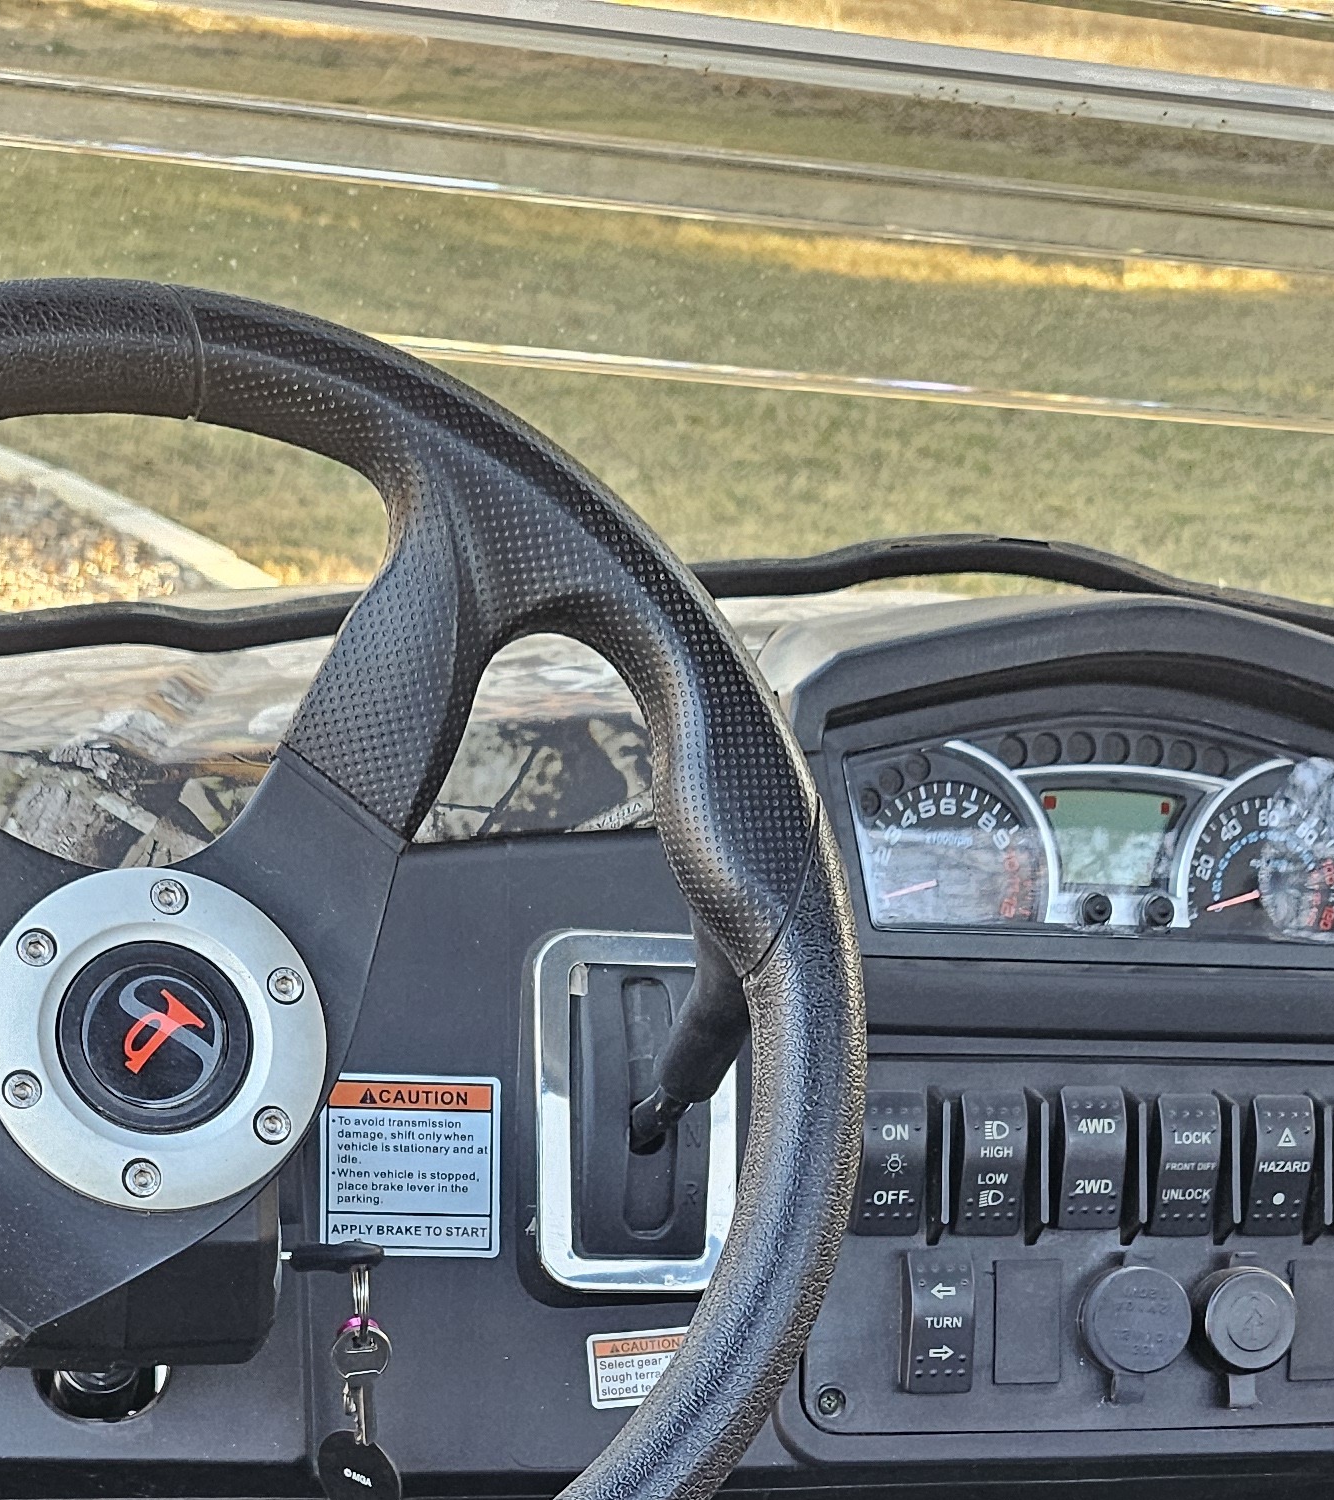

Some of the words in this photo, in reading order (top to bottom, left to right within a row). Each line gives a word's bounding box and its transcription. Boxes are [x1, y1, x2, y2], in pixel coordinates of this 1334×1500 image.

[918, 799, 936, 818] 5
[940, 798, 956, 815] 6
[961, 801, 979, 818] 7
[901, 808, 917, 828] 4
[978, 811, 997, 832] 8
[1258, 809, 1280, 826] 60
[1221, 818, 1242, 841] 40
[1296, 822, 1318, 846] 80
[993, 829, 1010, 850] 9
[1196, 854, 1215, 881] 20
[379, 1090, 468, 1105] CAUTION
[338, 1117, 351, 1127] To
[354, 1117, 385, 1127] avoid
[389, 1118, 462, 1129] transmission
[1078, 1119, 1115, 1135] 4WD
[337, 1130, 387, 1142] damage,
[391, 1131, 415, 1140] shift
[418, 1131, 442, 1144] only
[444, 1132, 474, 1142] when
[882, 1125, 909, 1141] ON
[1174, 1132, 1211, 1145] LOCK
[337, 1142, 378, 1152] vehicle
[381, 1144, 390, 1152] is
[393, 1144, 449, 1156] stationary
[453, 1145, 474, 1154] and
[477, 1145, 488, 1155] at
[980, 1146, 1013, 1158] HIGH
[337, 1154, 362, 1164] idle.
[1165, 1162, 1194, 1171] FRONT
[1197, 1162, 1217, 1171] DIFF
[1258, 1161, 1310, 1173] HAZARD
[337, 1168, 370, 1179] When
[374, 1169, 414, 1180] vehicle
[418, 1170, 427, 1180] is
[430, 1172, 479, 1184] stopped,
[978, 1173, 1008, 1186] LOW
[337, 1182, 368, 1193] place
[371, 1182, 404, 1192] brake
[406, 1183, 435, 1193] lever
[438, 1183, 447, 1193] in
[450, 1183, 469, 1193] the
[1075, 1179, 1111, 1195] 2WD
[337, 1195, 383, 1206] parking.
[874, 1190, 909, 1205] OFF
[1162, 1188, 1211, 1202] UNLOCK
[331, 1224, 374, 1235] APPLY
[377, 1225, 422, 1236] BRAKE
[425, 1226, 442, 1236] TO
[446, 1227, 487, 1238] START
[925, 1317, 963, 1329] TURN
[621, 1337, 680, 1353] CAUTION
[600, 1358, 635, 1370] Select
[637, 1358, 662, 1369] gear
[600, 1372, 632, 1385] rough
[635, 1369, 664, 1380] terra
[601, 1384, 638, 1397] sloped
